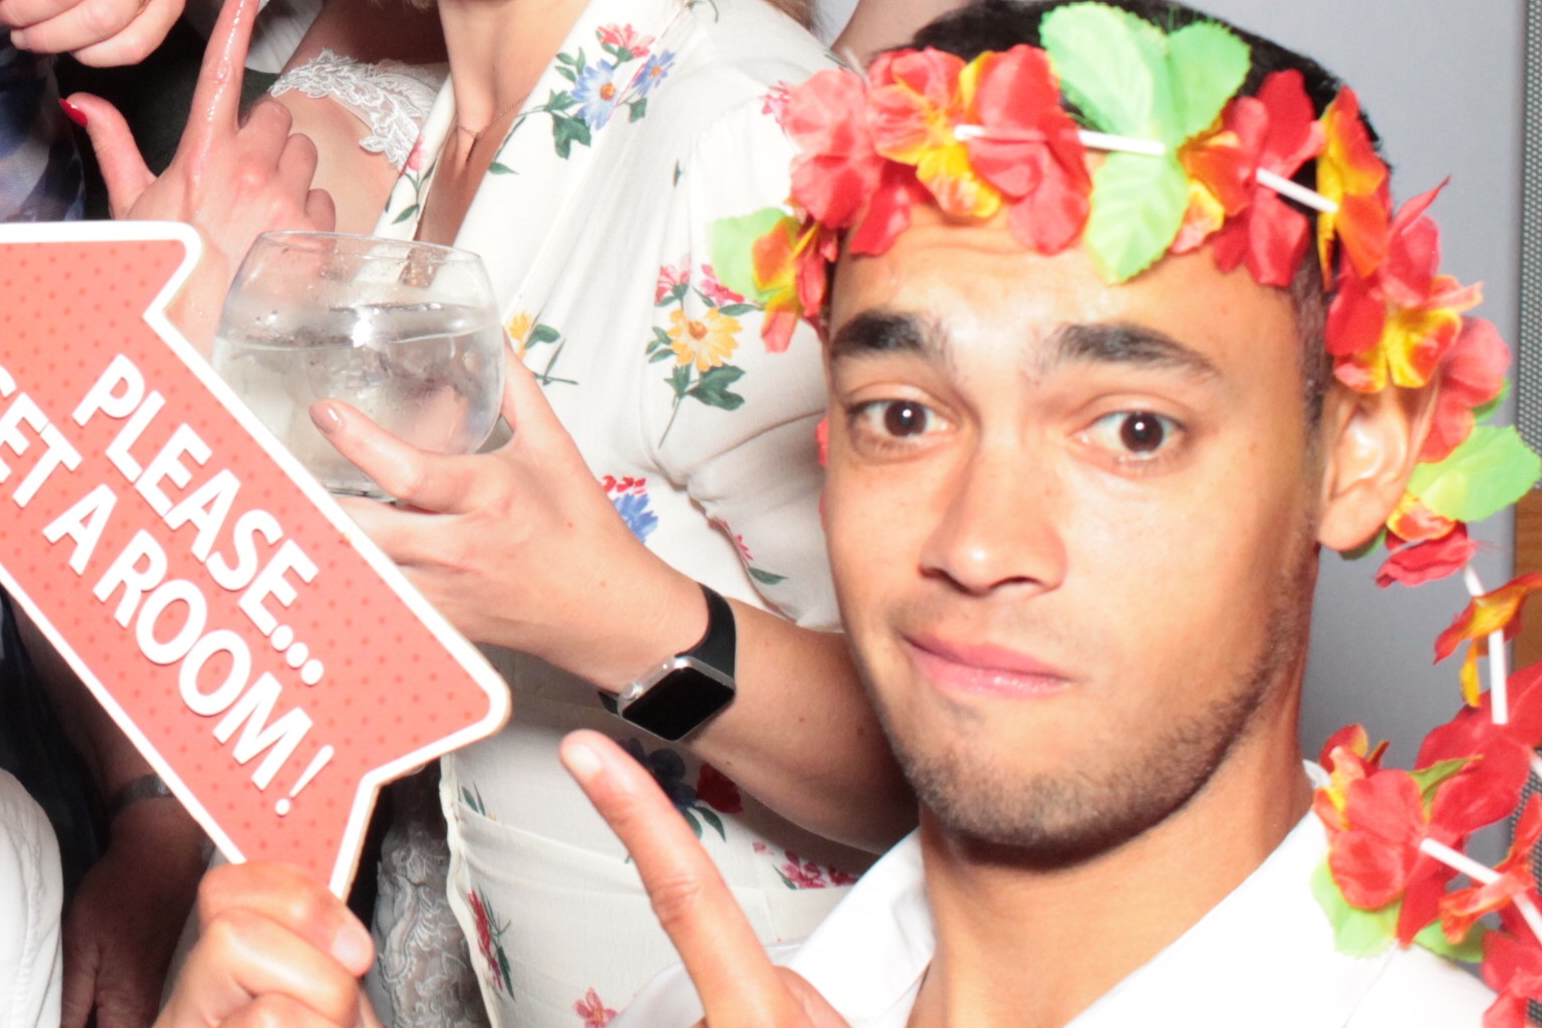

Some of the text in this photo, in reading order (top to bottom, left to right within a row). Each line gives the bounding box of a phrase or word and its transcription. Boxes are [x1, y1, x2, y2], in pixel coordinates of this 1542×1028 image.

[43, 483, 117, 574] A
[93, 529, 334, 816] ROOM!
[73, 354, 323, 685] PLEASE...
